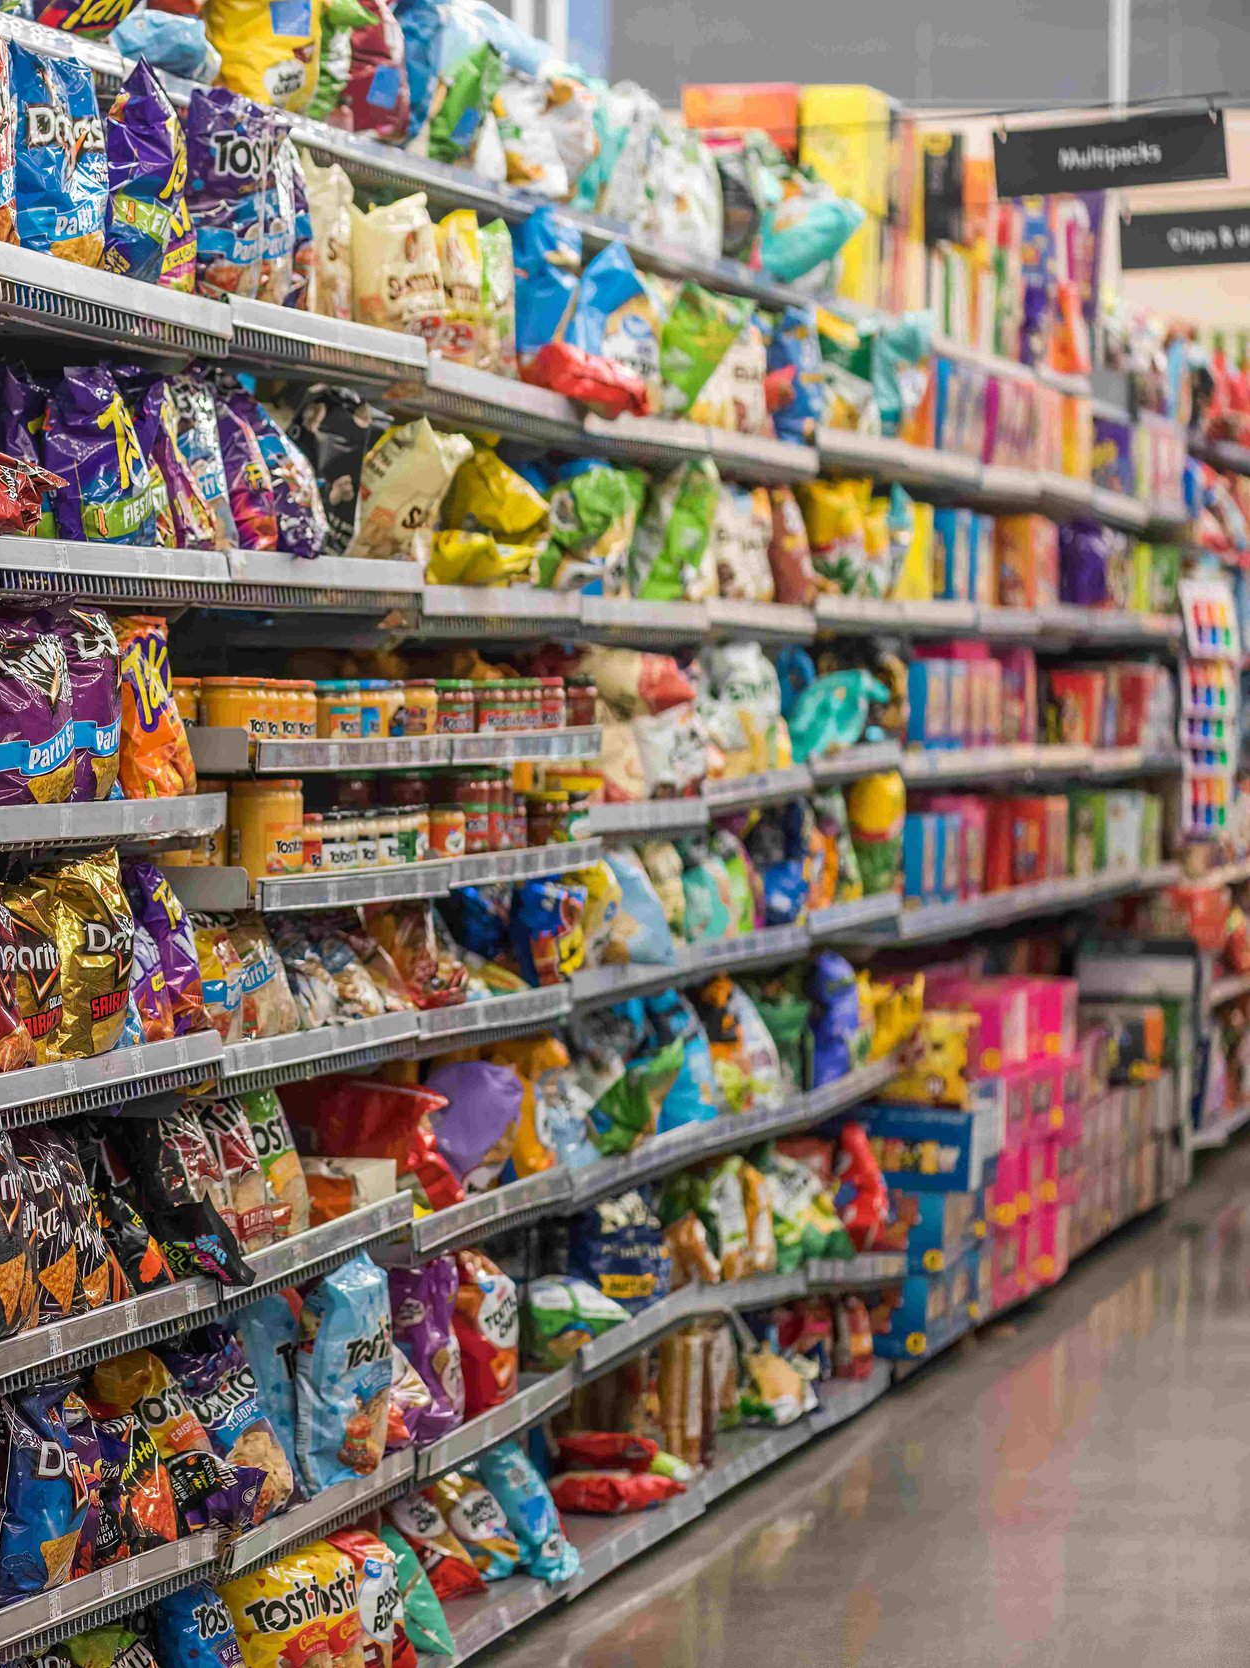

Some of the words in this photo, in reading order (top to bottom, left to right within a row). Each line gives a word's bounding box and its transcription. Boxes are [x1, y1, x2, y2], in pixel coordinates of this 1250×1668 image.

[1057, 140, 1163, 171] Multipacks
[1167, 226, 1217, 254] Chips
[28, 738, 67, 770] Party
